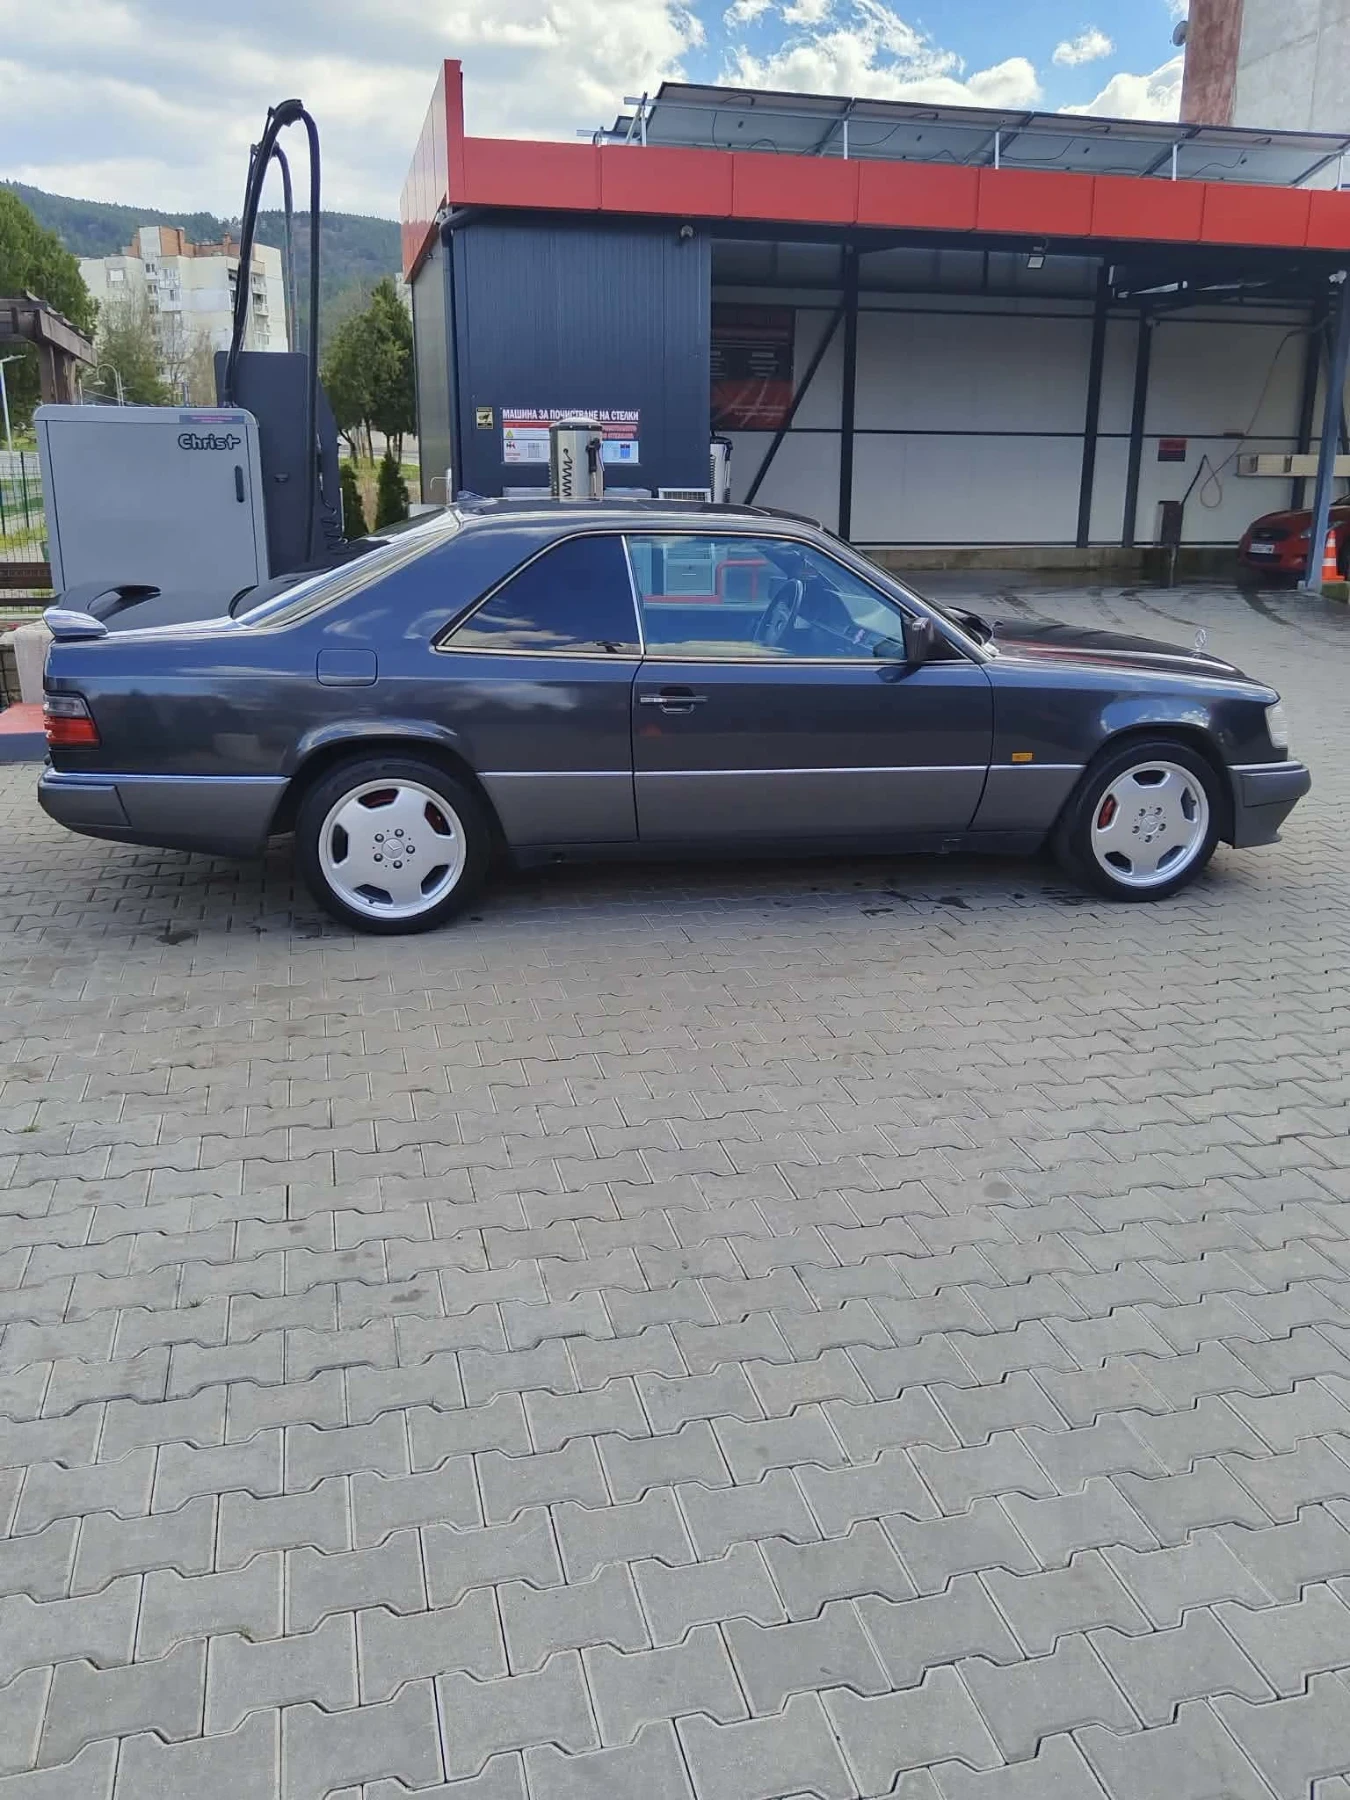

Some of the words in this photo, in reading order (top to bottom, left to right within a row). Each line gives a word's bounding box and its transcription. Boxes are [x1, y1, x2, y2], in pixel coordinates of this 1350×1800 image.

[502, 409, 537, 420] МАШИНА
[538, 409, 548, 420] ЗА
[600, 410, 610, 420] НА
[611, 410, 639, 421] СТЕЛКИ
[178, 433, 241, 450] Christ
